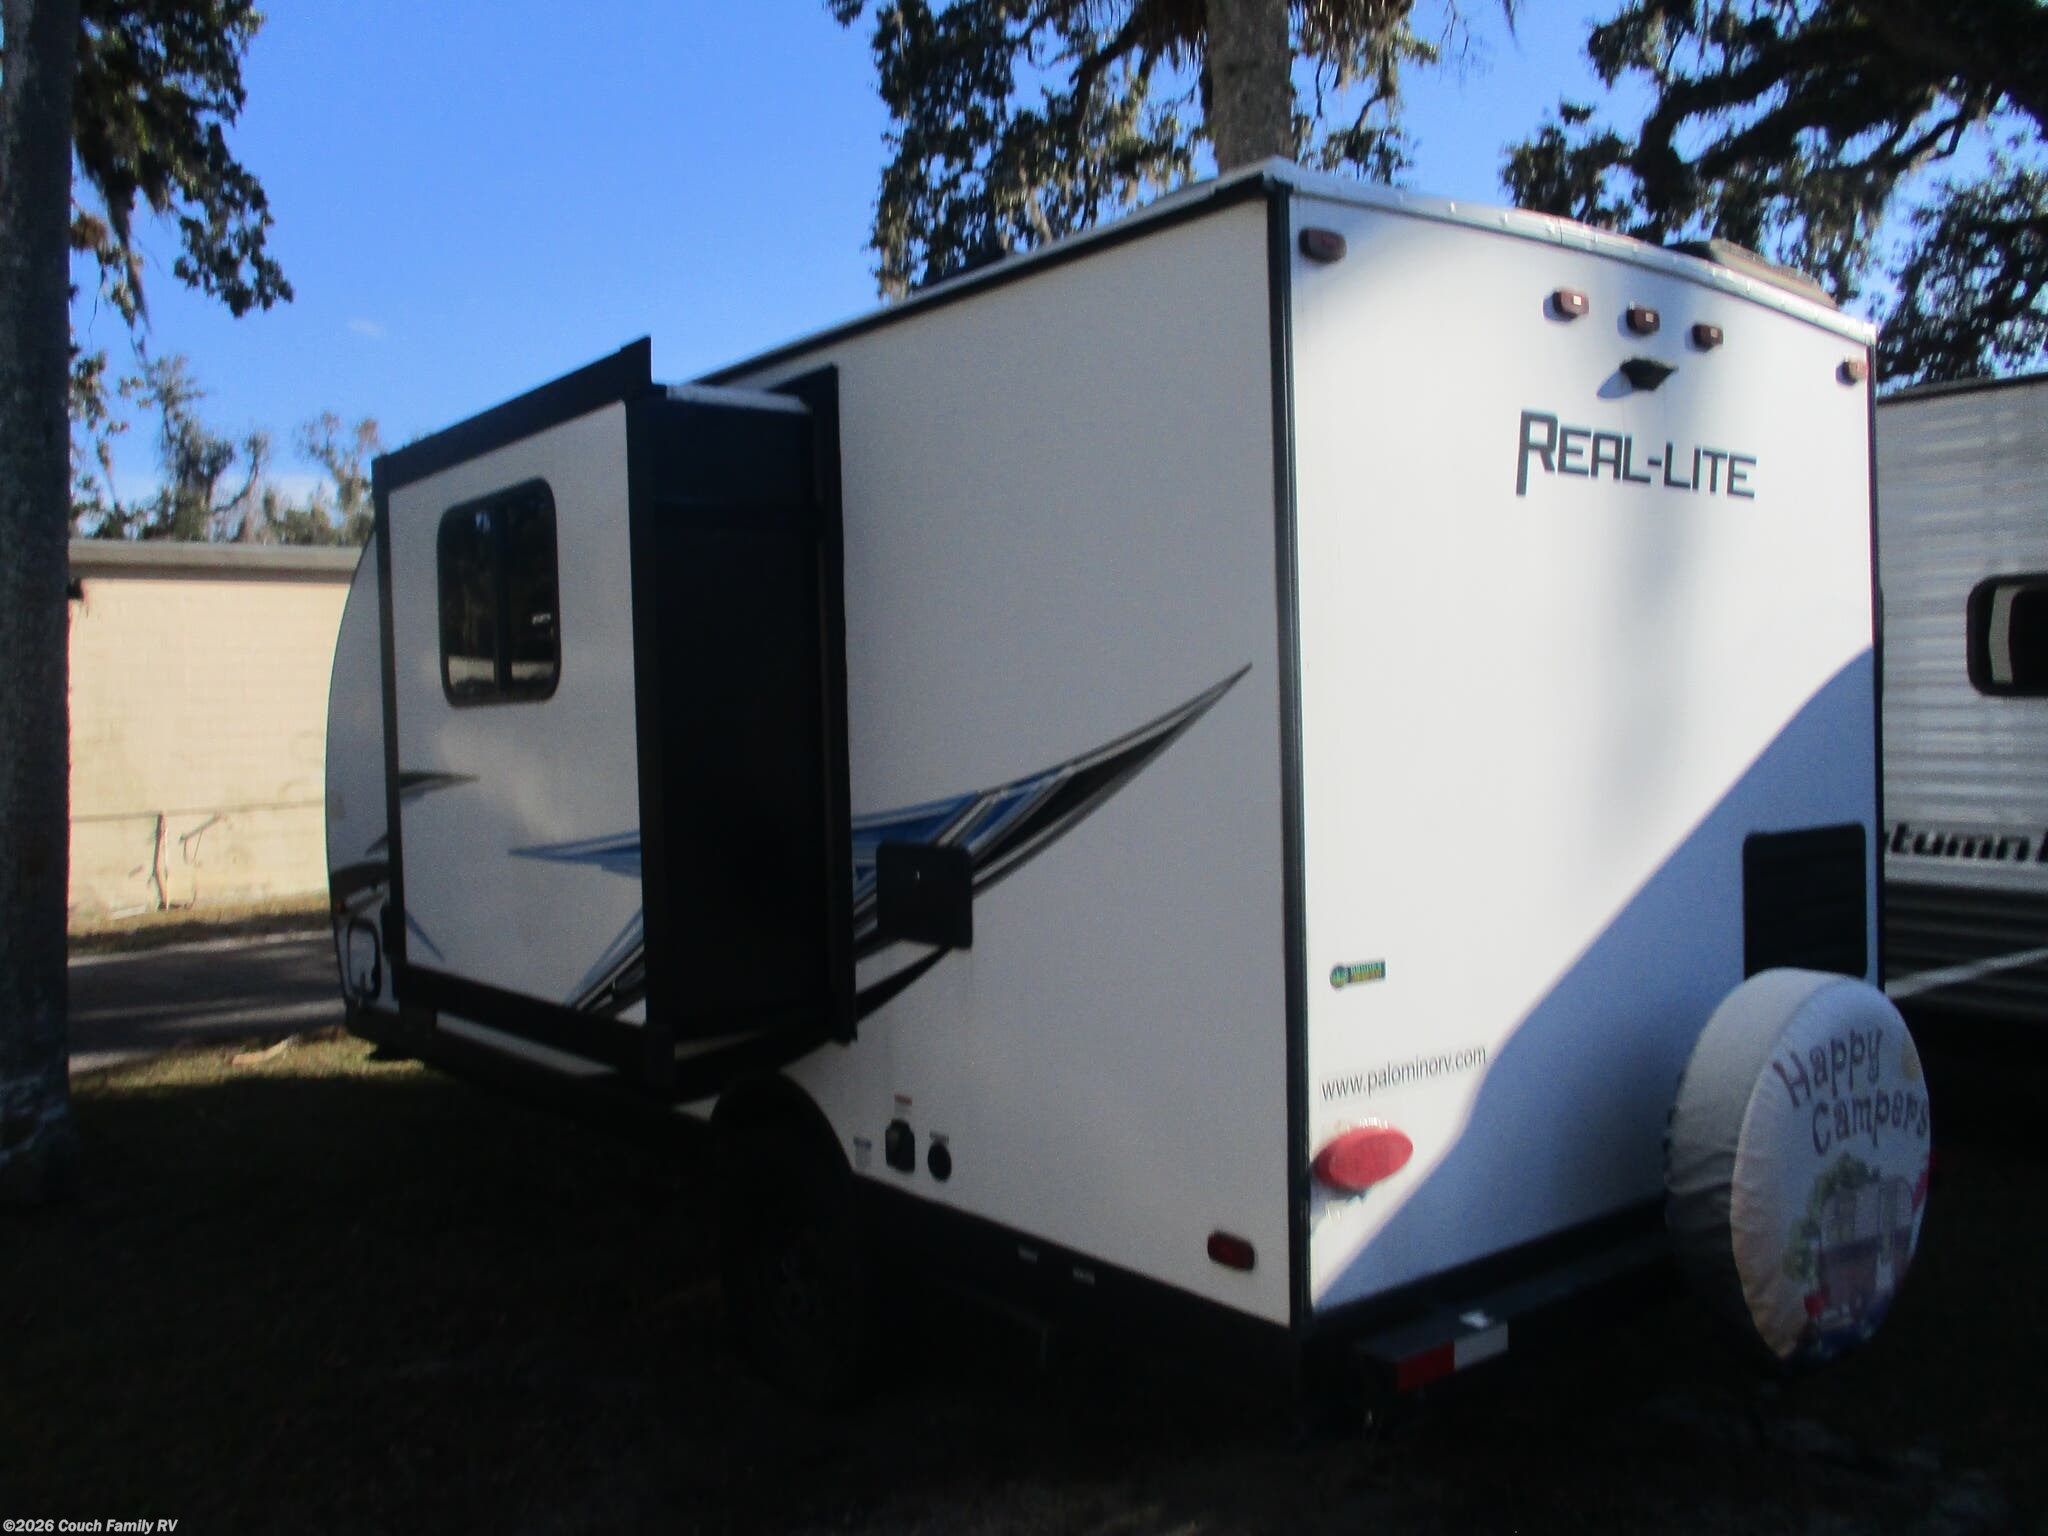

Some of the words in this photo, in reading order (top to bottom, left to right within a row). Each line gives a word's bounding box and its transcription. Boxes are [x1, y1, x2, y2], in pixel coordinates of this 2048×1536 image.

[1516, 409, 1756, 498] REAL-LITE
[1884, 823, 2030, 861] tumn
[1322, 1046, 1487, 1101] www.palominorv.com
[1773, 1027, 1882, 1108] Happy
[1812, 1089, 1928, 1155] Campers
